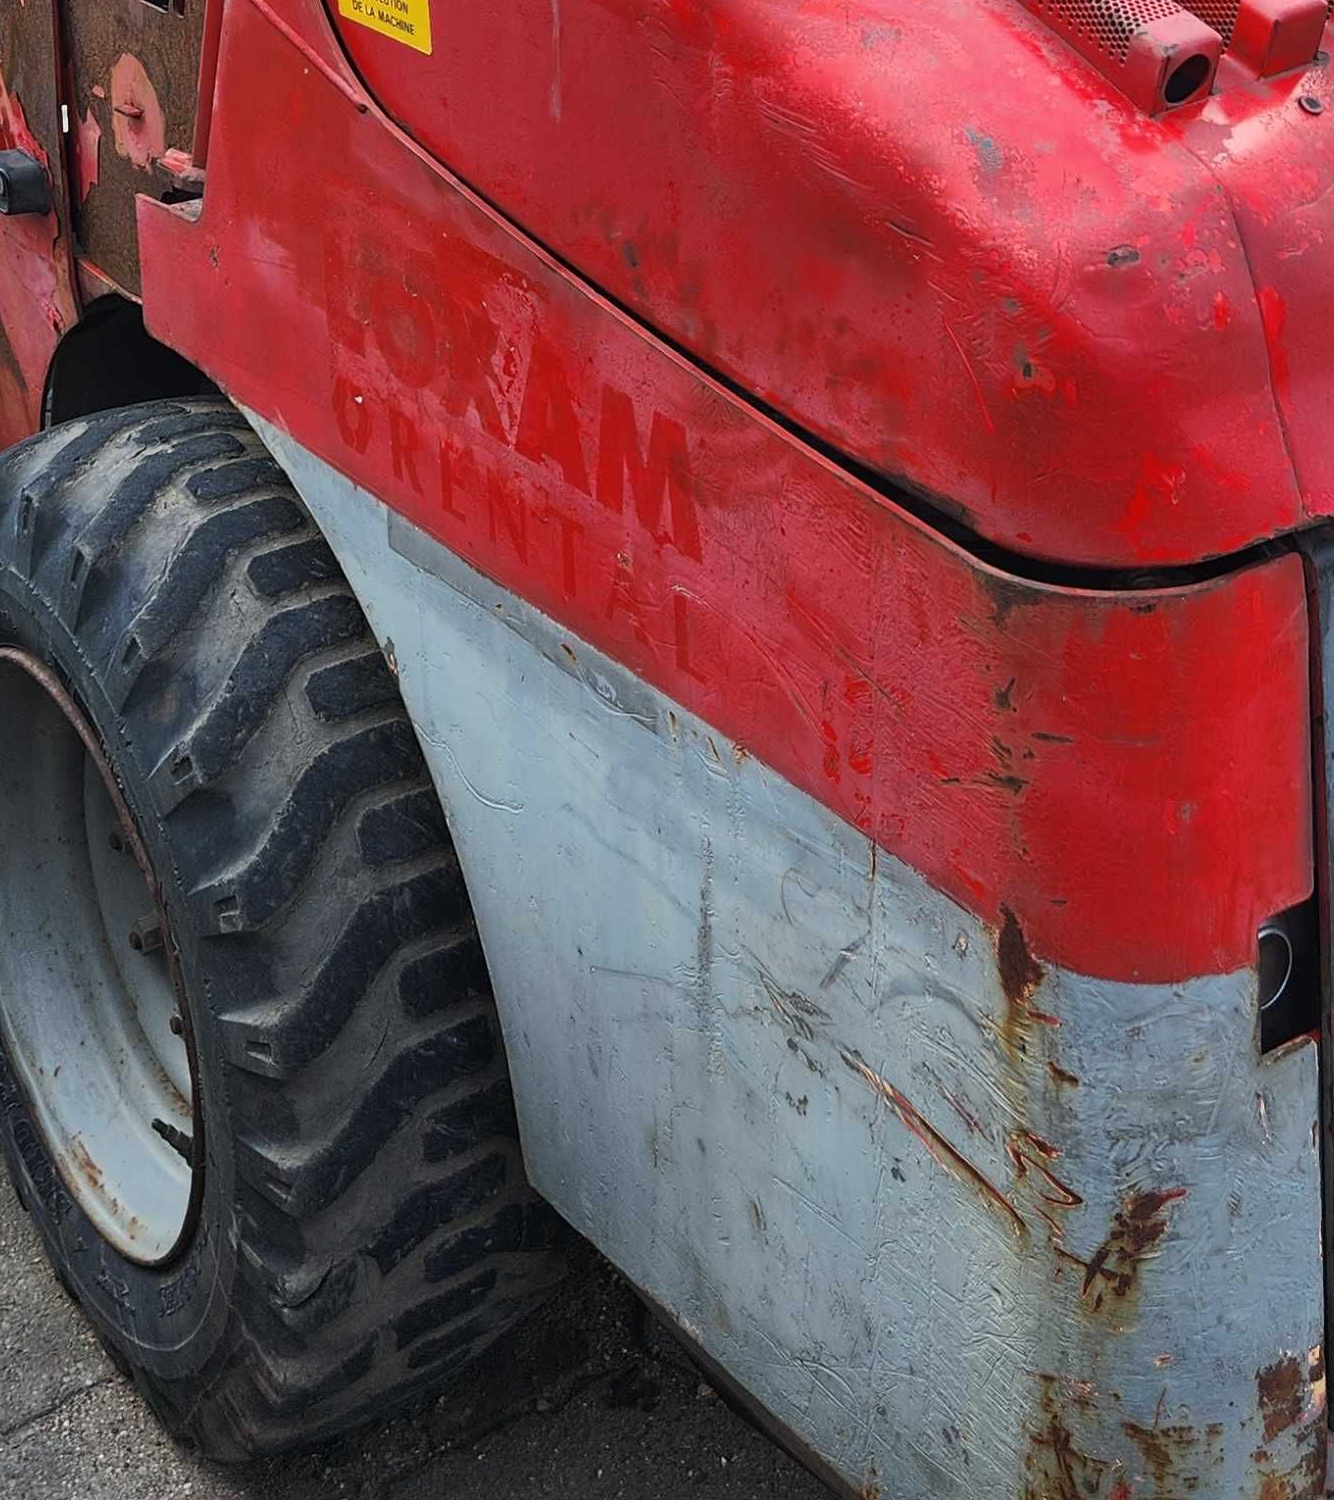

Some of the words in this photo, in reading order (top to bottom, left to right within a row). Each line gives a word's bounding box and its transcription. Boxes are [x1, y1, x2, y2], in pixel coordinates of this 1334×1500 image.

[352, 0, 364, 14] DE
[365, 3, 376, 19] LA
[378, 9, 416, 36] MACHINE
